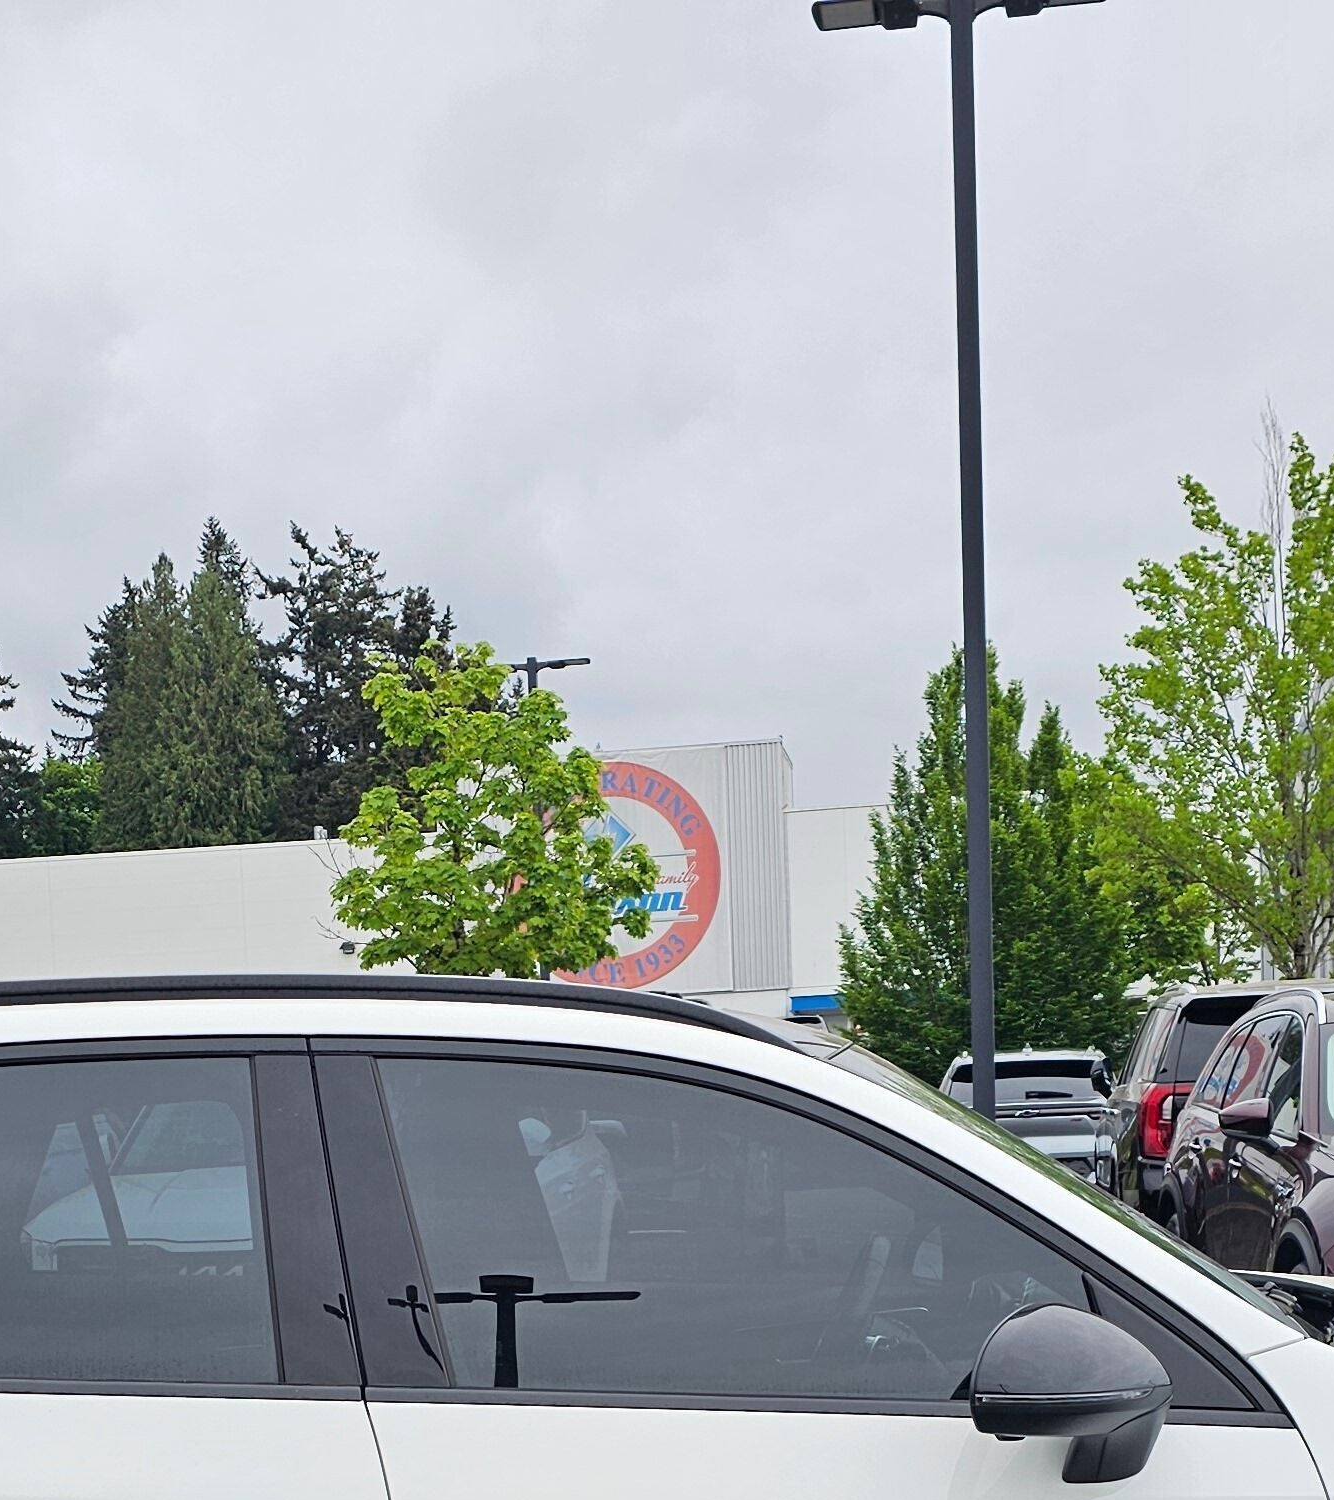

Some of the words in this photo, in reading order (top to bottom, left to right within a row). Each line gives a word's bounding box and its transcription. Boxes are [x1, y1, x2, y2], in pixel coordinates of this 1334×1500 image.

[601, 769, 701, 837] RATING
[656, 860, 699, 893] amily
[635, 934, 686, 978] 1933
